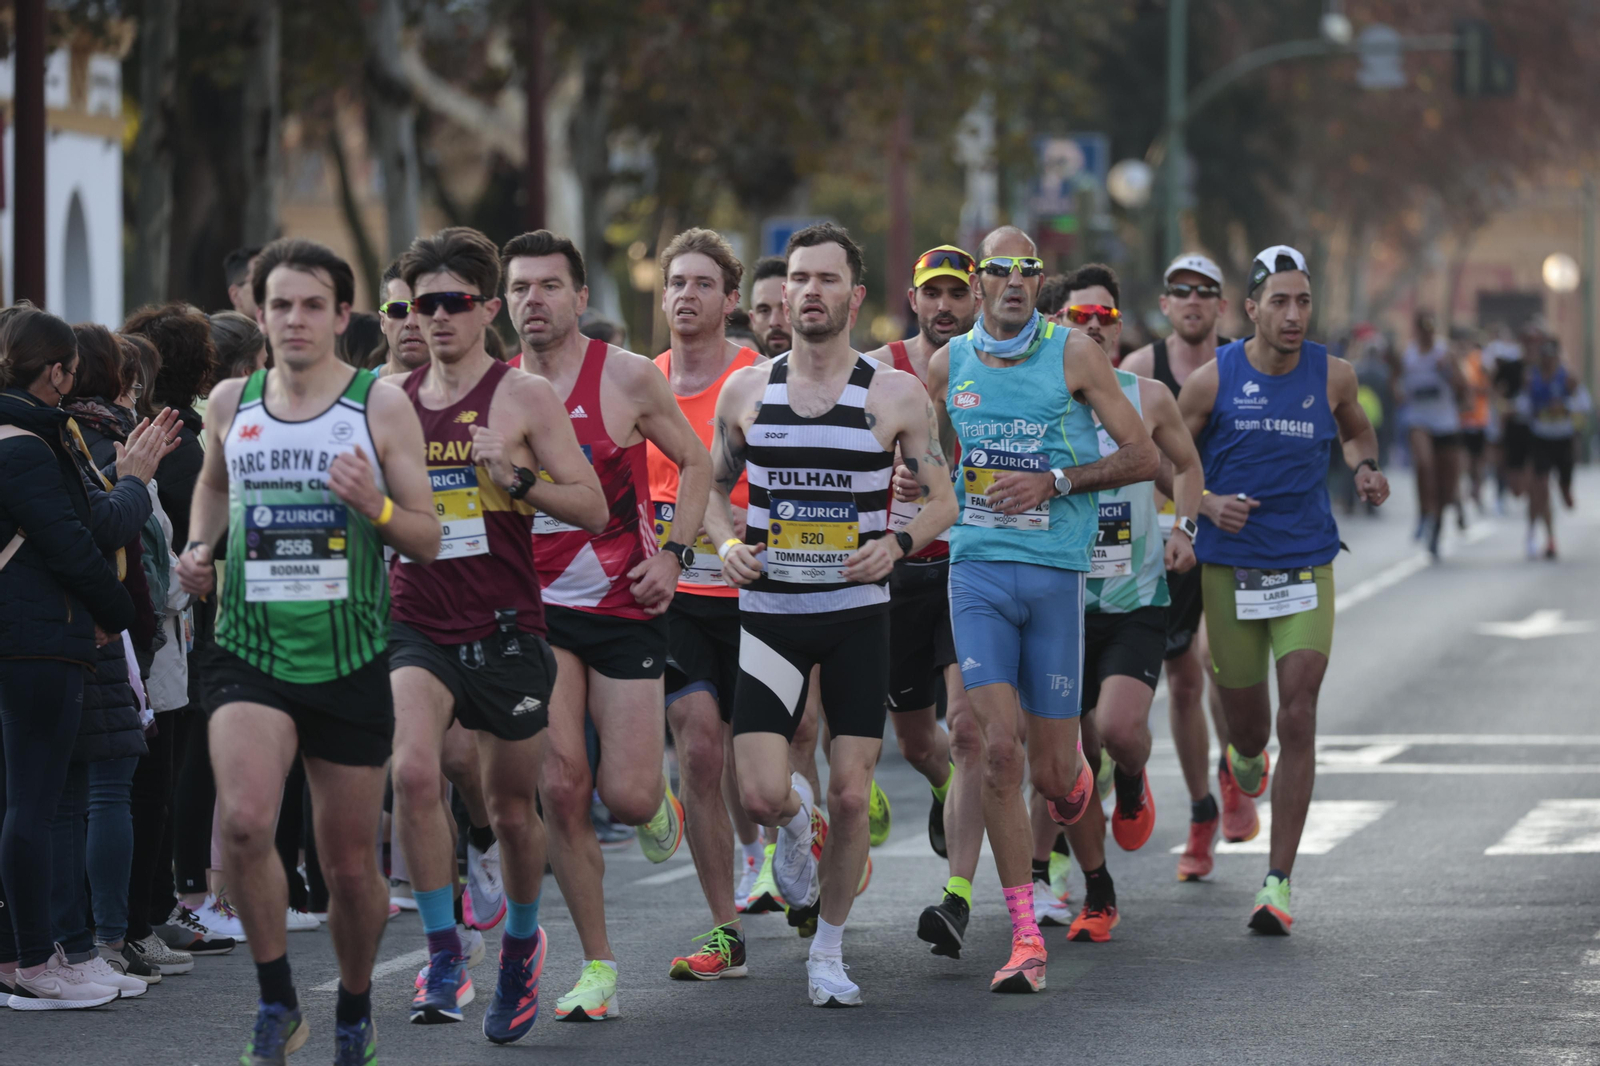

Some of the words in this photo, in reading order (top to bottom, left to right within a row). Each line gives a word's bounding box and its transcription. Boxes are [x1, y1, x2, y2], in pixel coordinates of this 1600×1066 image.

[958, 418, 1048, 438] TrainingRey
[1234, 418, 1260, 431] team
[764, 431, 788, 439] soar
[979, 438, 1021, 453] Tello
[231, 451, 266, 479] PARC
[270, 448, 313, 471] BRYN
[990, 455, 1039, 469] ZURICH
[244, 478, 303, 493] Running
[429, 473, 466, 488] RICH
[767, 470, 852, 489] FULHAM
[275, 509, 335, 523] ZURICH
[797, 506, 849, 518] ZURICH
[801, 532, 825, 545] 520
[275, 538, 313, 556] 2556
[270, 564, 320, 576] BODMAN
[1261, 572, 1289, 587] 2629
[1263, 589, 1289, 601] LARBI
